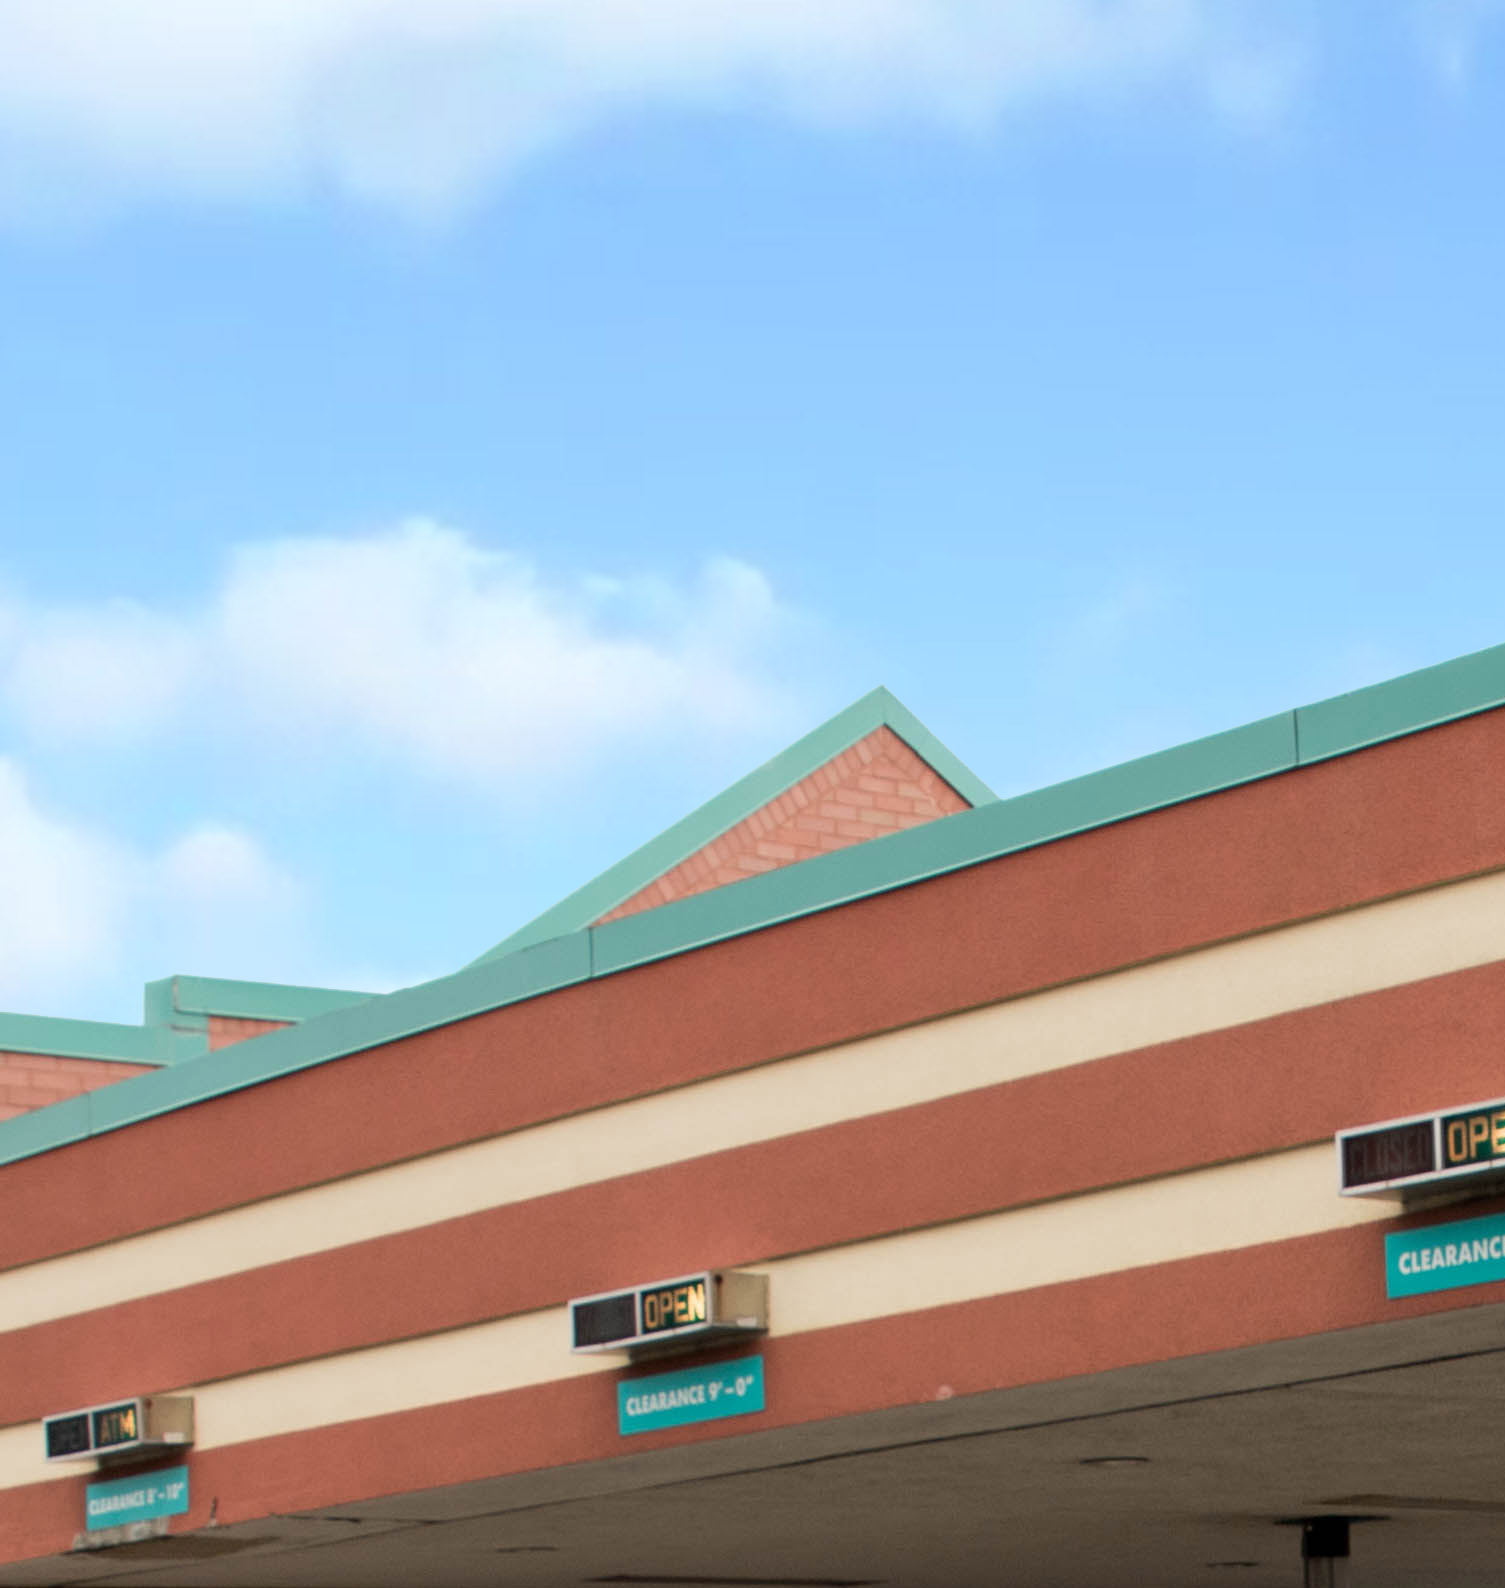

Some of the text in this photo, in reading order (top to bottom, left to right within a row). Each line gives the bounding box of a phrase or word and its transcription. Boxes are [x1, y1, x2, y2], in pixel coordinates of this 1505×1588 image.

[645, 1283, 705, 1329] OPEN
[626, 1384, 706, 1416] CLEARANCE
[101, 1408, 136, 1443] ATM
[89, 1490, 145, 1515] CLEARANCE
